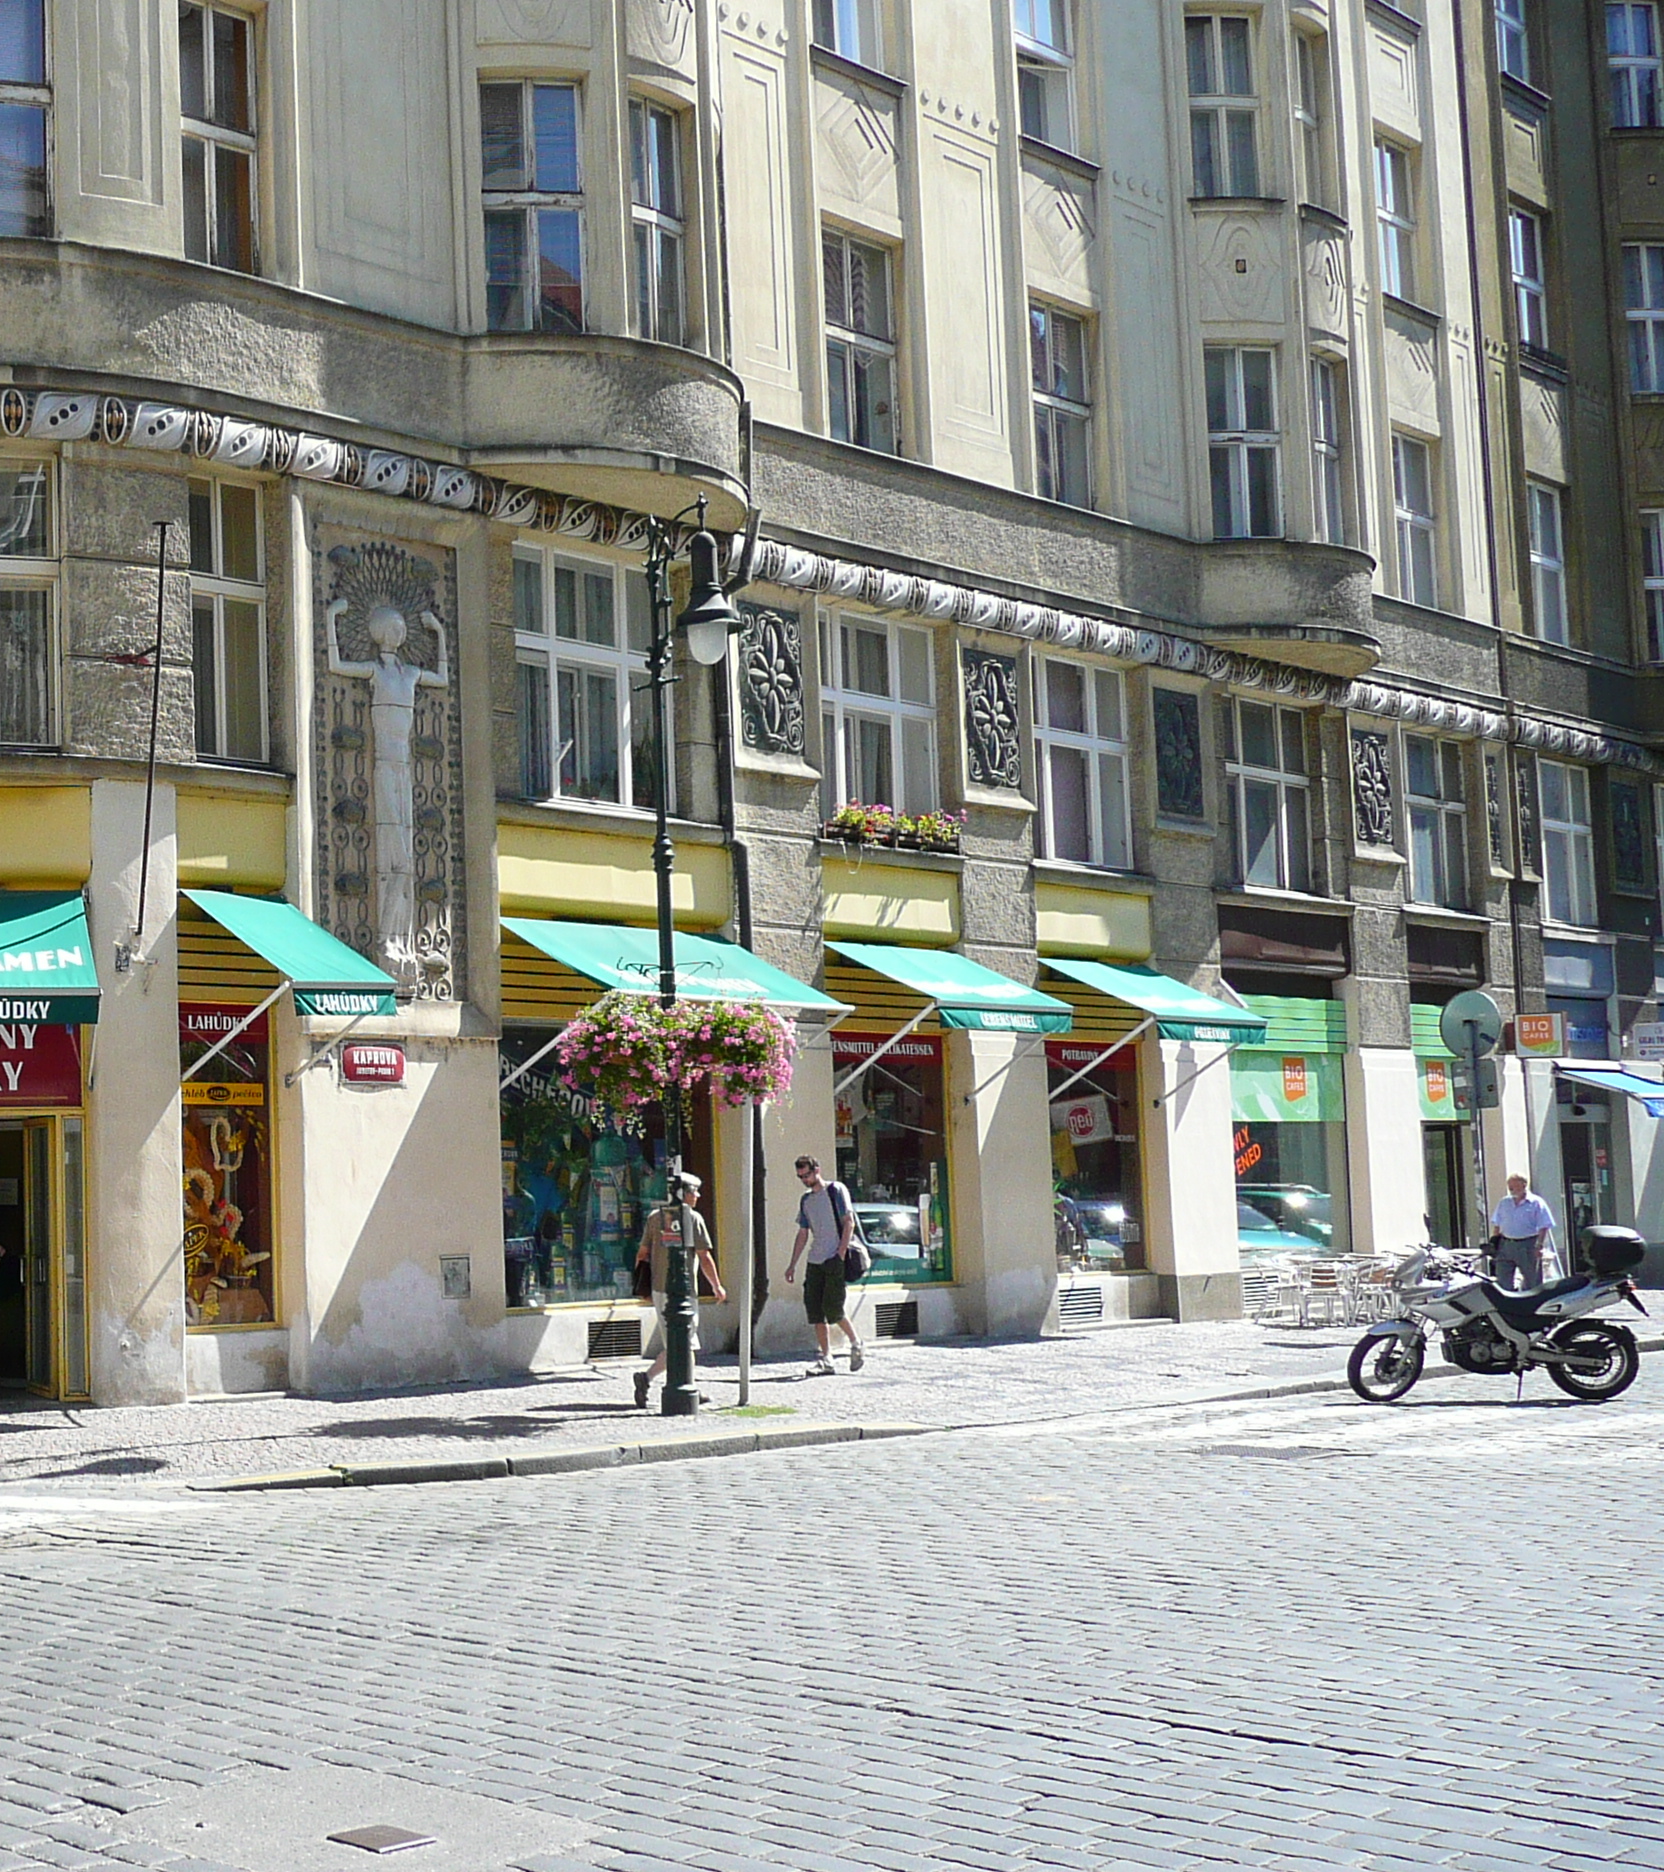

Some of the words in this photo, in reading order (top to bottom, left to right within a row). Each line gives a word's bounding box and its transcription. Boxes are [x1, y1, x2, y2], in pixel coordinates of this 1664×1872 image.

[314, 991, 379, 1013] LAHŮDKY
[1522, 1020, 1549, 1032] BIO
[352, 1050, 398, 1066] KAPROVA
[1284, 1065, 1304, 1080] BIO
[1235, 1142, 1263, 1176] ENED
